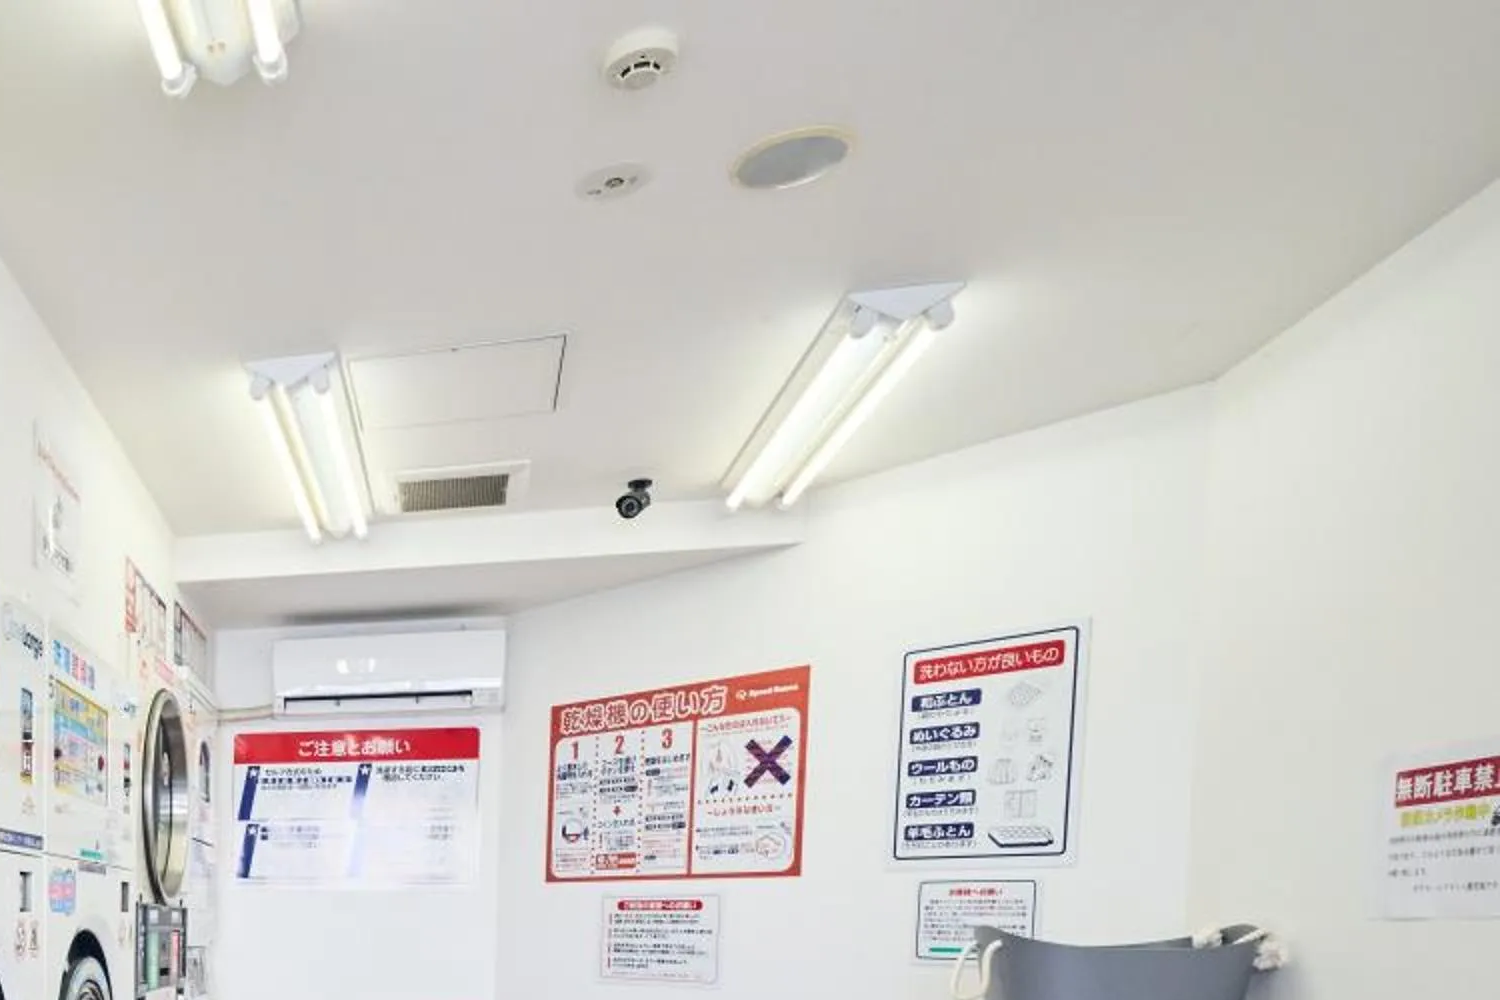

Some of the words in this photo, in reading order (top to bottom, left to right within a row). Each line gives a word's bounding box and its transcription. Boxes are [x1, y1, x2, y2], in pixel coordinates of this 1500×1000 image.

[919, 646, 1060, 680] 洗わない方が良いもの
[561, 685, 728, 733] 乾燥機の使い方
[661, 728, 674, 749] 3
[912, 726, 977, 741] ぬいぐるみ
[297, 736, 412, 758] ご注意とお願い
[614, 735, 626, 755] 2
[911, 759, 975, 775] ウールもの
[907, 825, 971, 839] 羊毛ふとん
